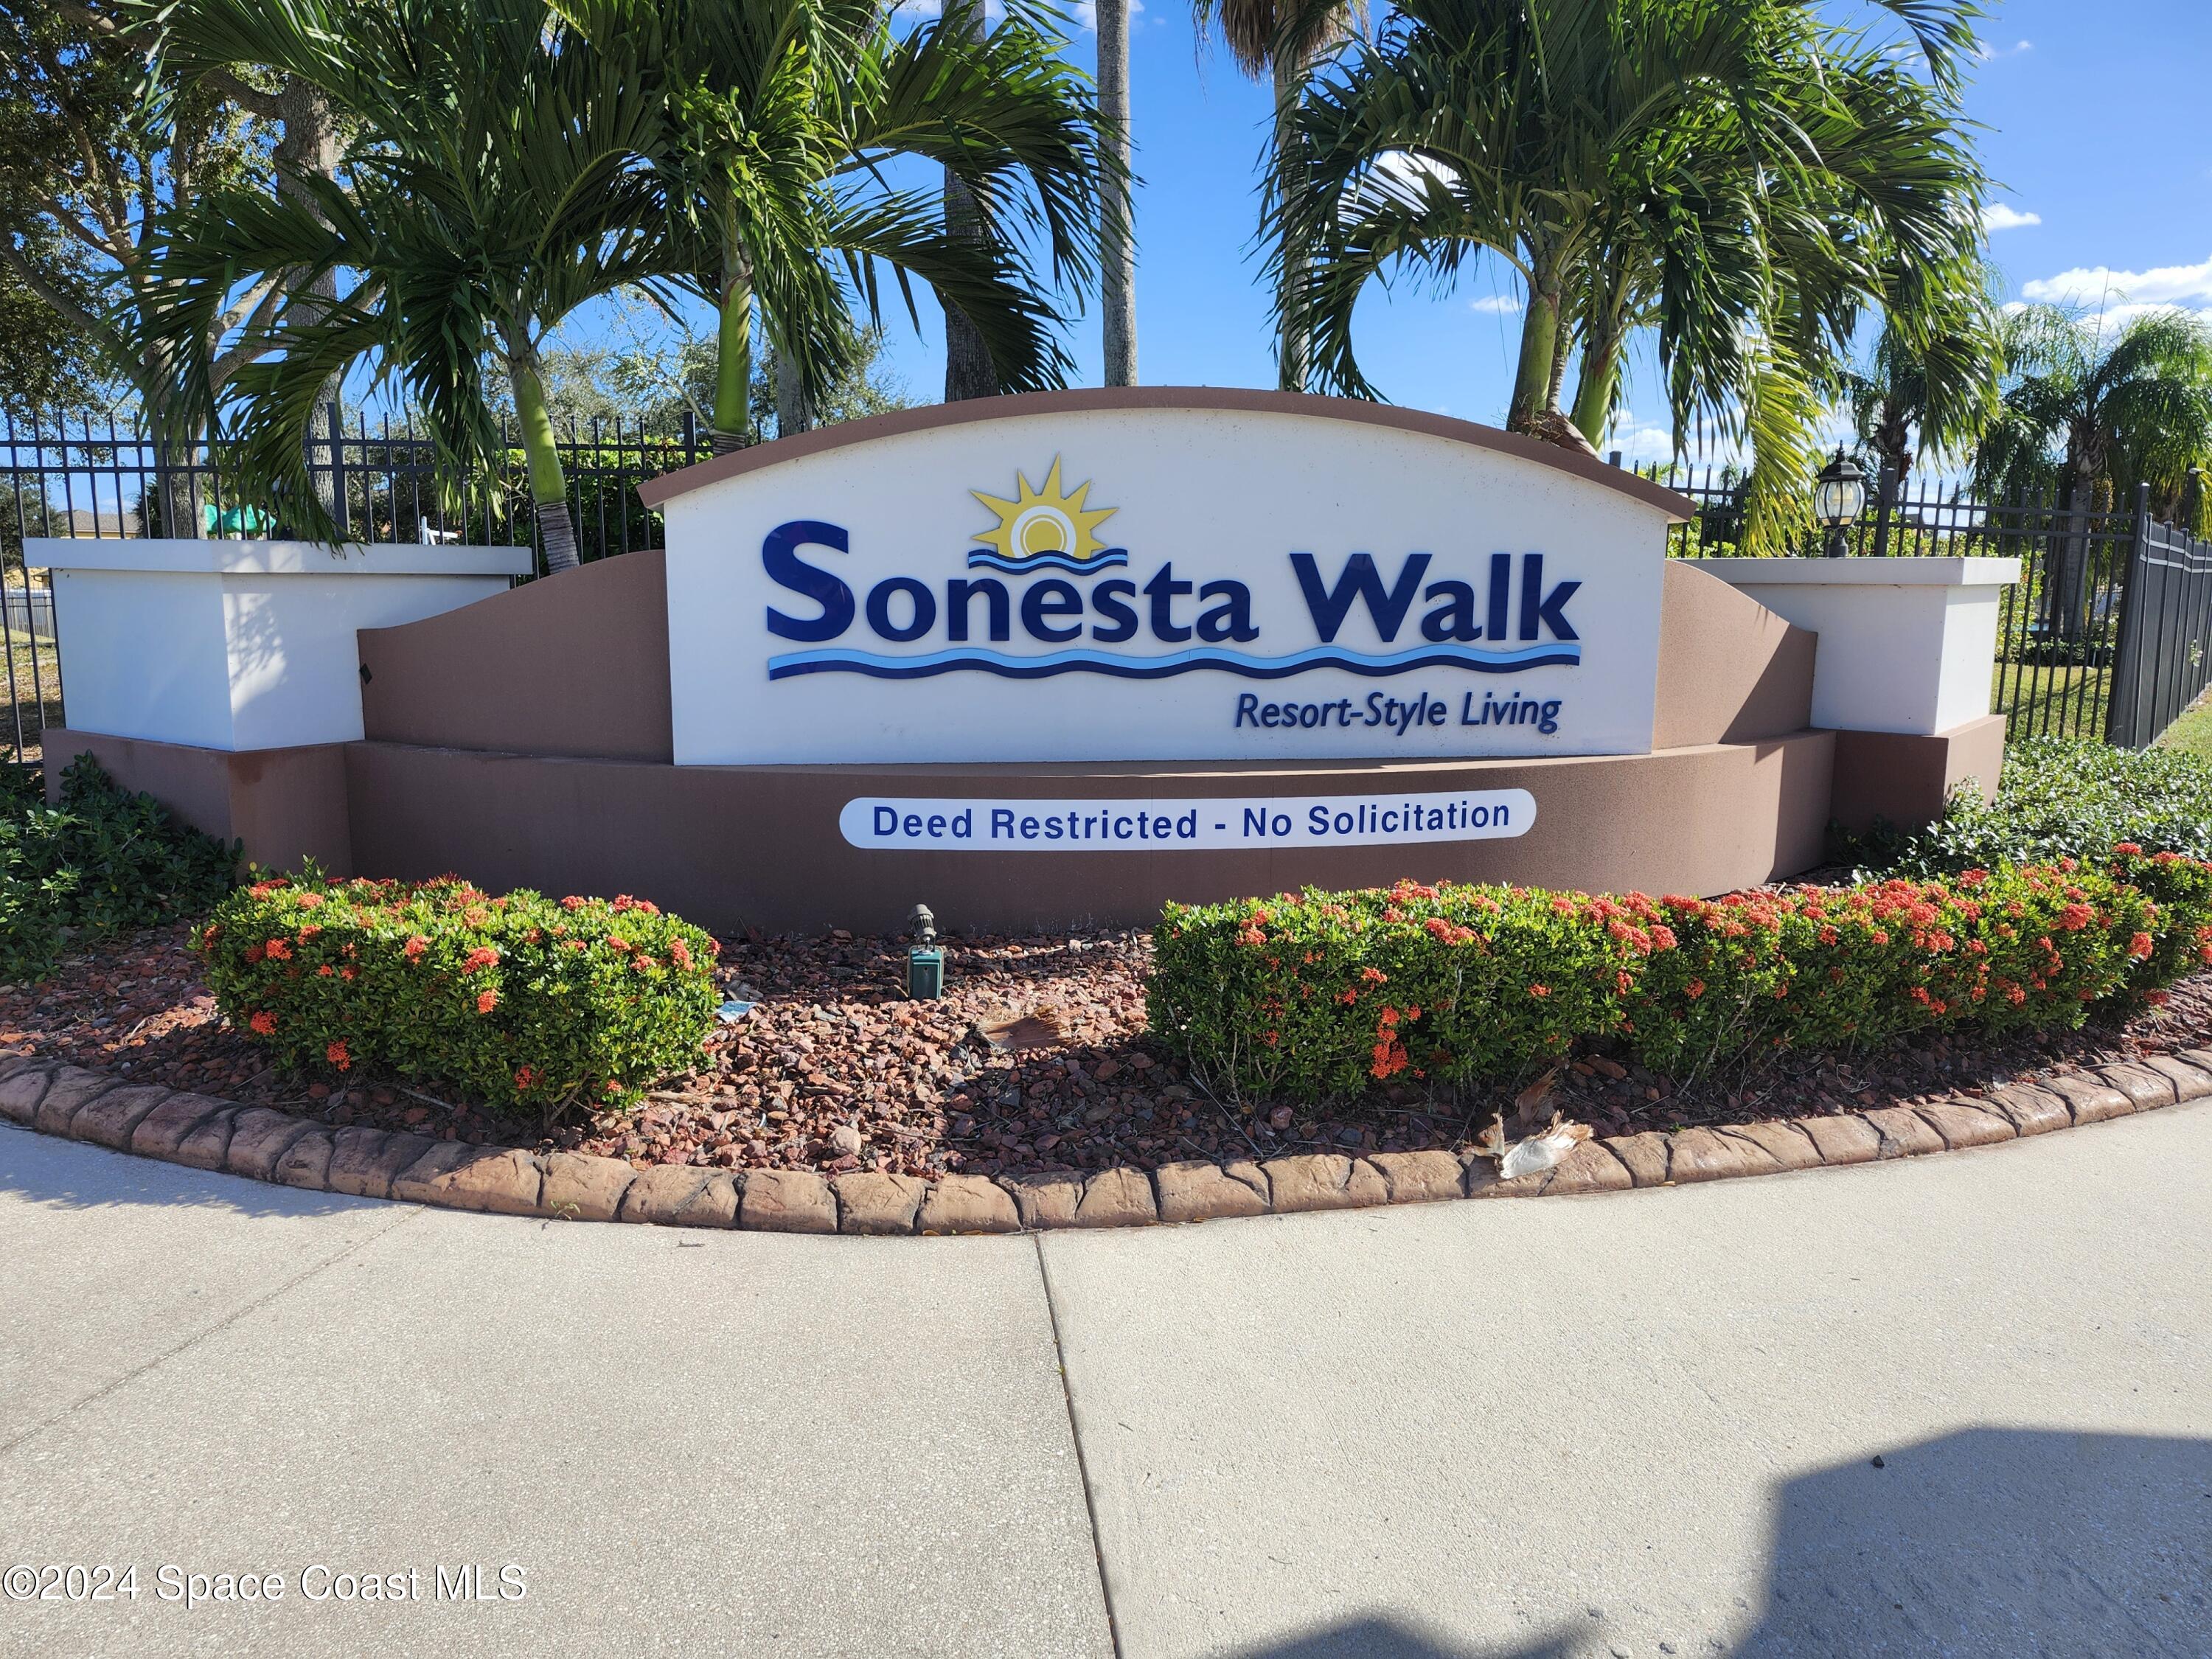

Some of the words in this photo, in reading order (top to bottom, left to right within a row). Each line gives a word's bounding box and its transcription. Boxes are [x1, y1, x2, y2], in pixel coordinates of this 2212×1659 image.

[762, 520, 1260, 644] Sonesta
[1288, 552, 1584, 644] Walk
[1234, 692, 1447, 737] Resort-Style
[1459, 692, 1562, 737] Living
[874, 806, 972, 838] Deed
[991, 808, 1197, 840] Restricted
[1243, 807, 1292, 838] No
[1308, 800, 1510, 835] Solicitation
